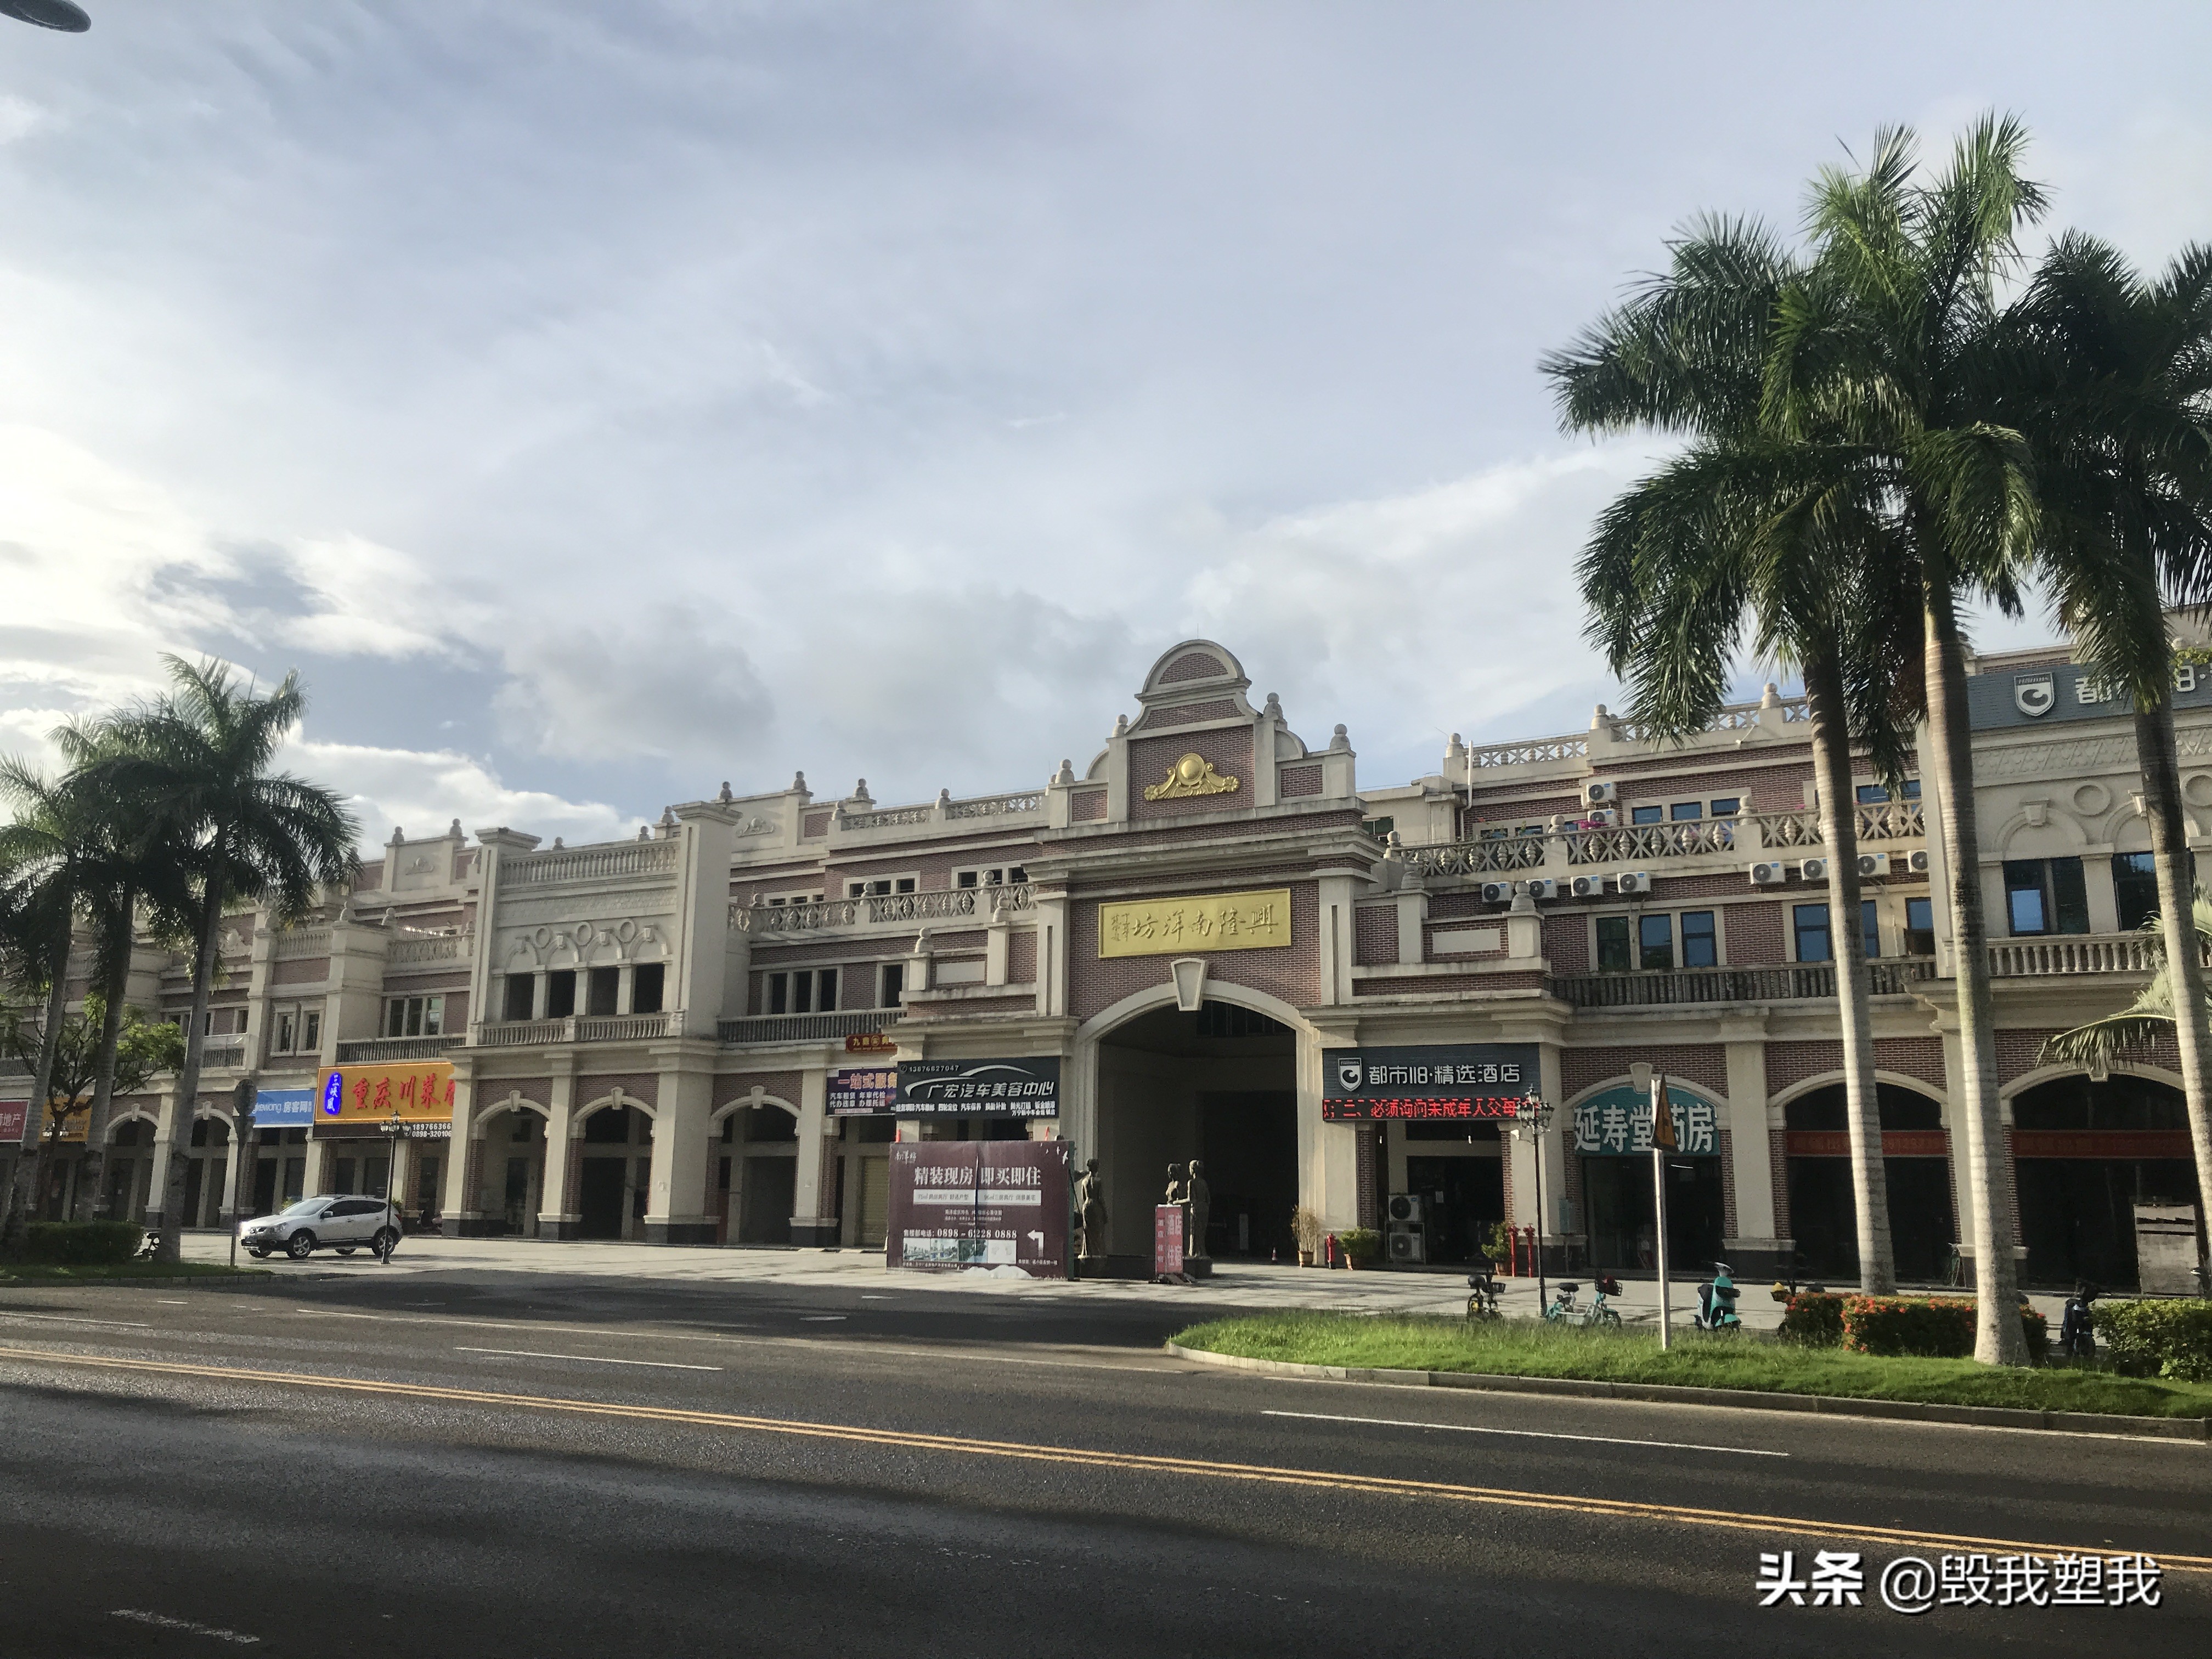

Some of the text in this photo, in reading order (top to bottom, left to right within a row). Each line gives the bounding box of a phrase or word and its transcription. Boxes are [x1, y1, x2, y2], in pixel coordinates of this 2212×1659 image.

[838, 1072, 898, 1090] 一站式服务
[927, 1081, 1055, 1098] 广宏汽车美容中心
[914, 1166, 1042, 1186] 精装现房 即买即住
